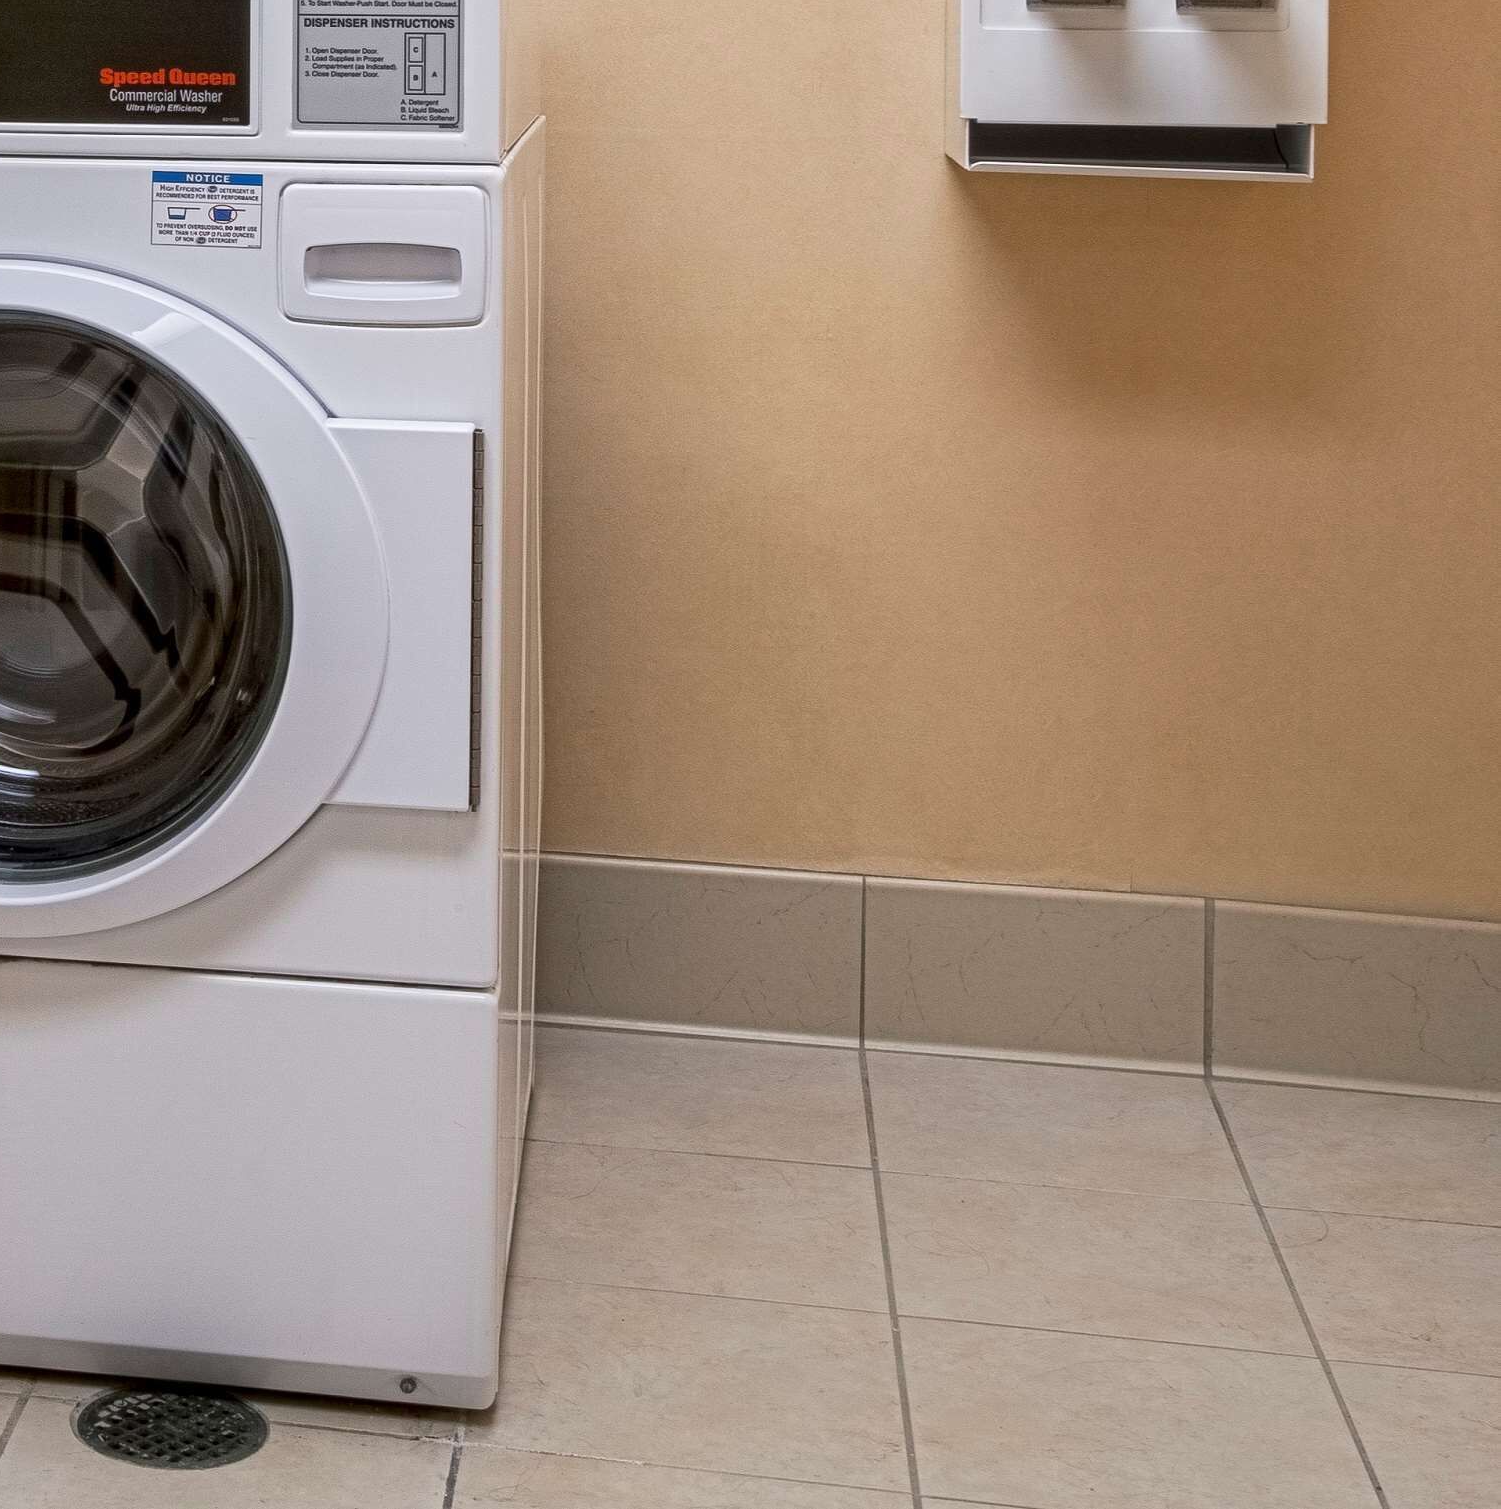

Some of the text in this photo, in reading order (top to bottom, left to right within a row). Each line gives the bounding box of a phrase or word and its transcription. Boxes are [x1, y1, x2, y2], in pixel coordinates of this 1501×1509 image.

[304, 19, 455, 28] DISPENSER INSTRUCTIONS
[100, 68, 236, 87] Speed Queen
[110, 89, 222, 102] Commercial Washer
[147, 104, 165, 112] High
[168, 105, 206, 114] Efficiency
[186, 174, 230, 182] NOTICE
